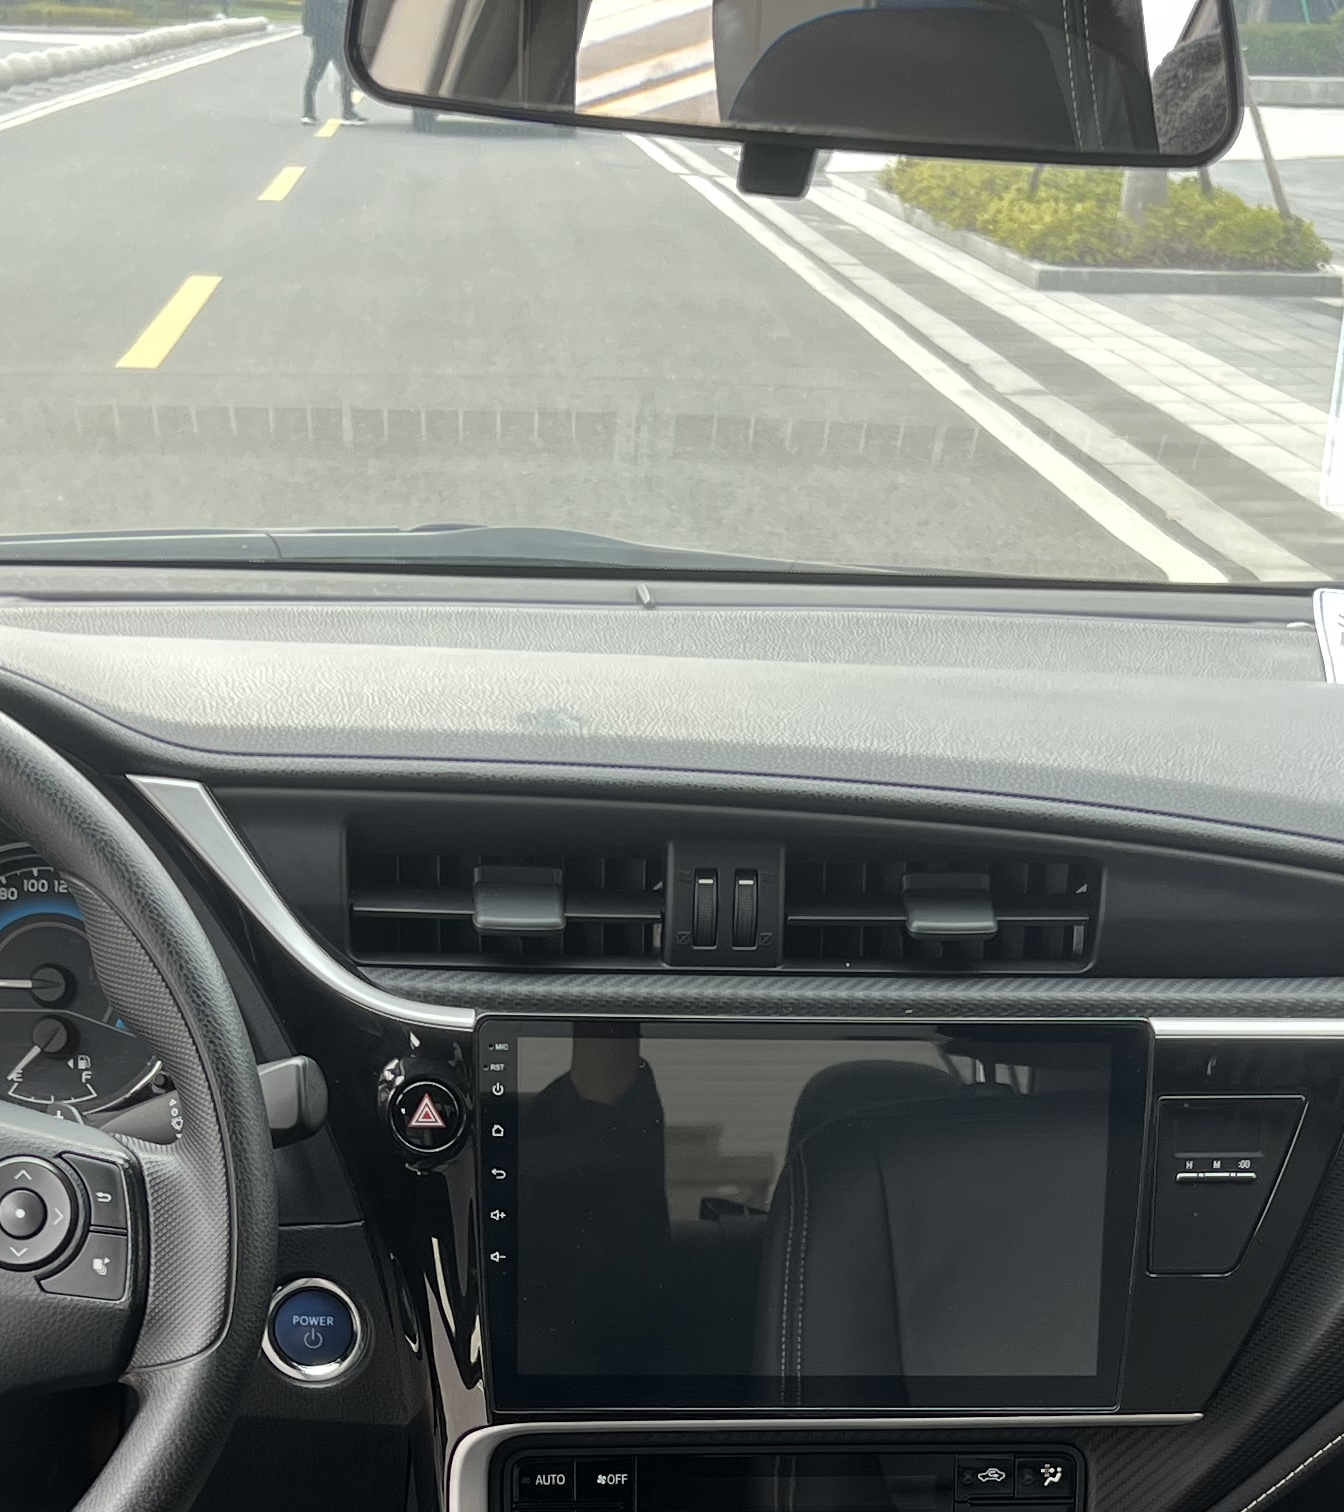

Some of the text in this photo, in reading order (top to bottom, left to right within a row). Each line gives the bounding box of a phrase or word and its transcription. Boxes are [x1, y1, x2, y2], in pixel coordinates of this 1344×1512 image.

[23, 879, 48, 892] 100
[54, 880, 68, 893] 12
[82, 1071, 92, 1083] F
[292, 1315, 334, 1327] POWER
[535, 1474, 565, 1485] AUTO
[607, 1474, 628, 1485] OFF
